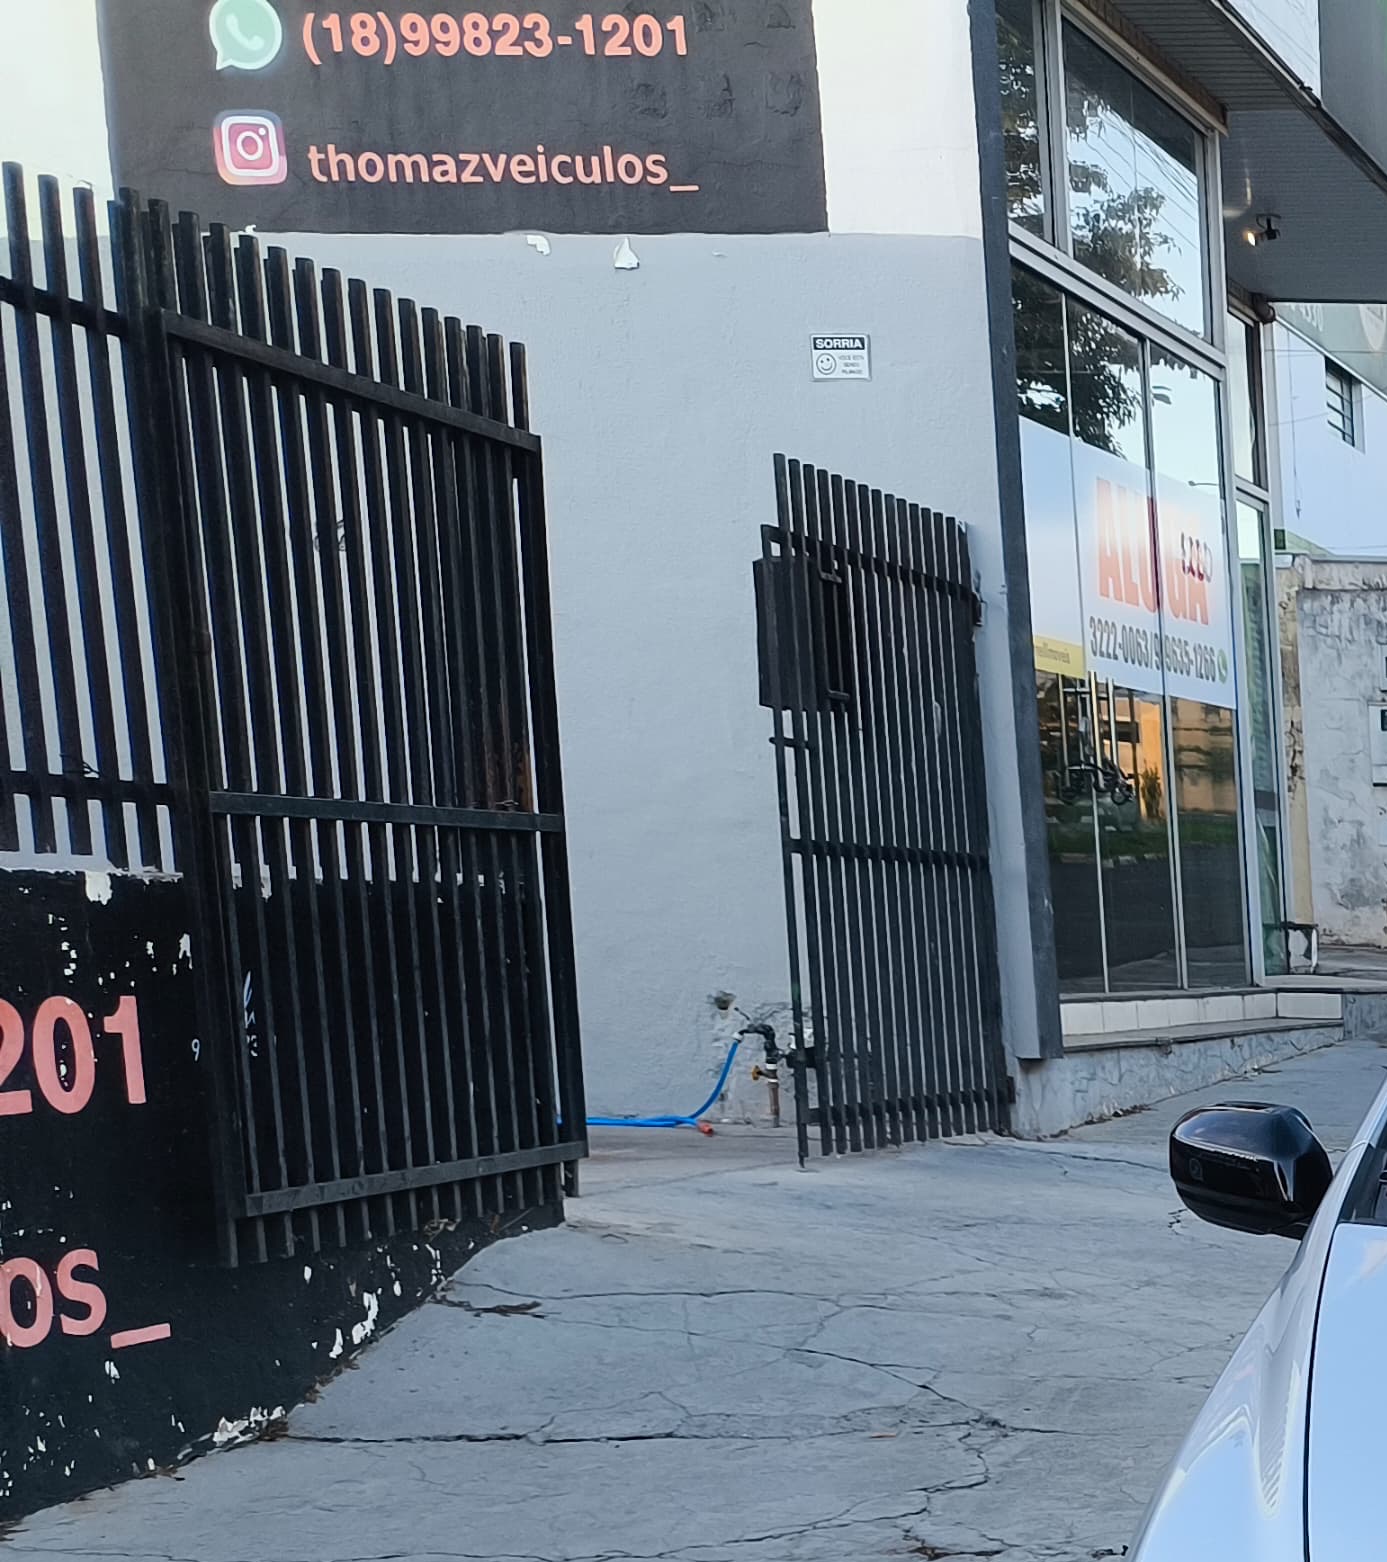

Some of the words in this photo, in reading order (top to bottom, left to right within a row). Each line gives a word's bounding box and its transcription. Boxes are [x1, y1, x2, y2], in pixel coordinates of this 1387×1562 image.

[302, 11, 689, 65] (18)99823-1201
[307, 143, 700, 192] thomazveiculos_
[815, 338, 863, 349] SORRIA
[1096, 477, 1209, 626] ALUGA
